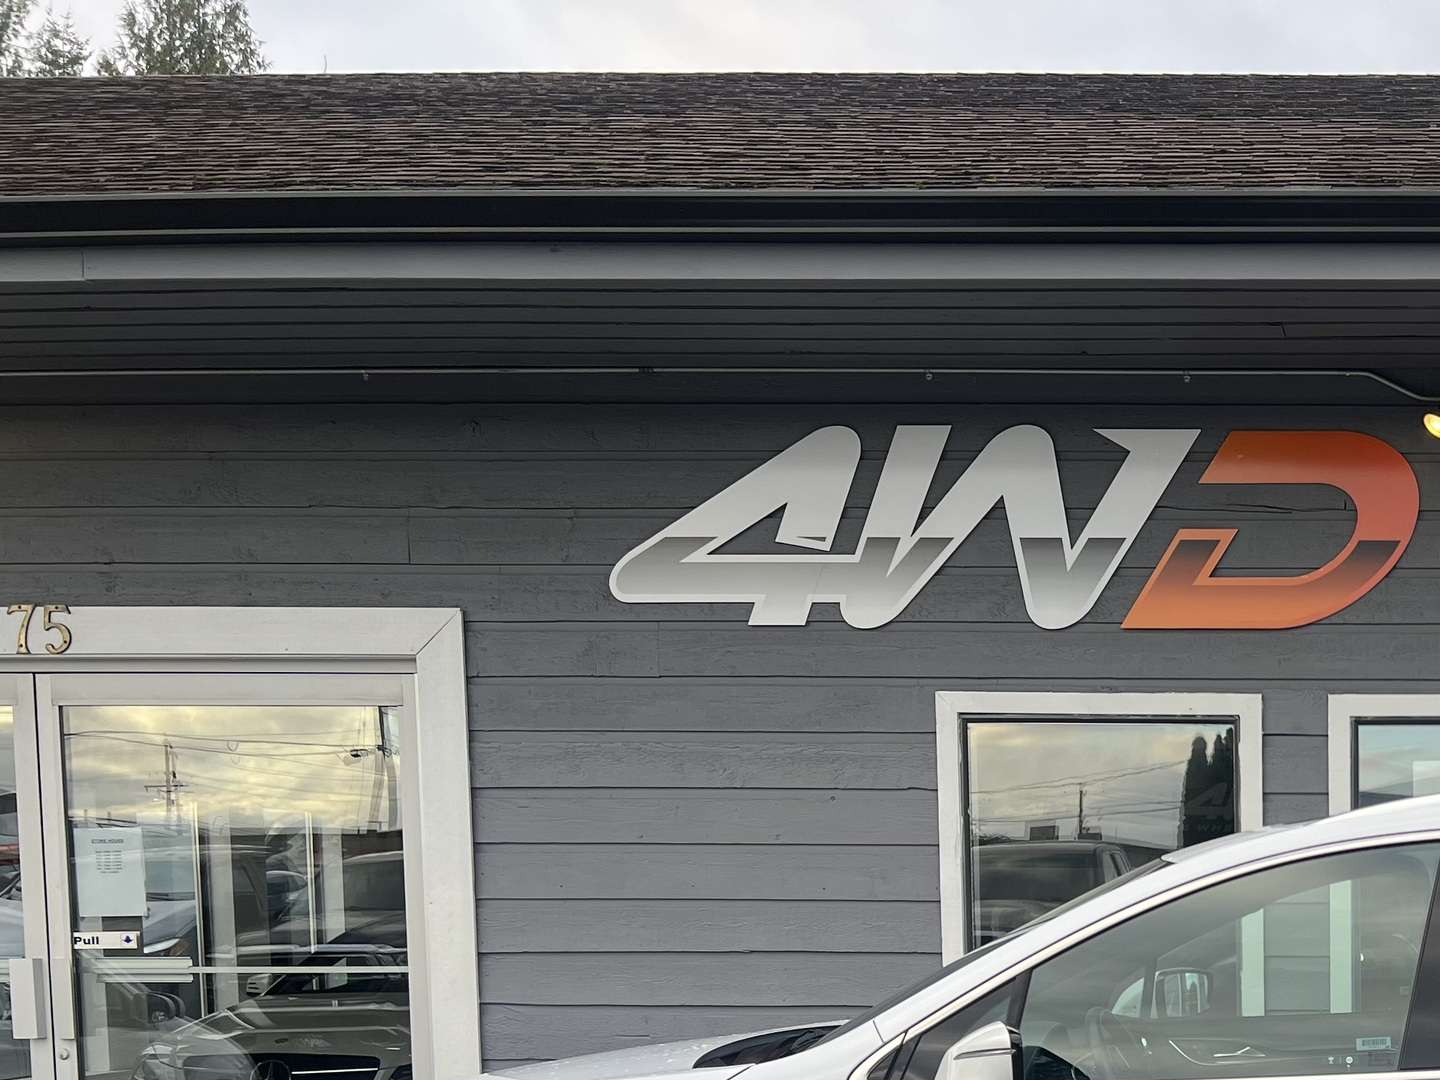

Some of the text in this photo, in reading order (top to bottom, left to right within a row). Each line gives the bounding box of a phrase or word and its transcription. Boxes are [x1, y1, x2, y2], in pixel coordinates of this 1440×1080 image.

[609, 424, 1420, 631] 4WD
[7, 603, 72, 655] 75
[73, 936, 99, 945] Pull
